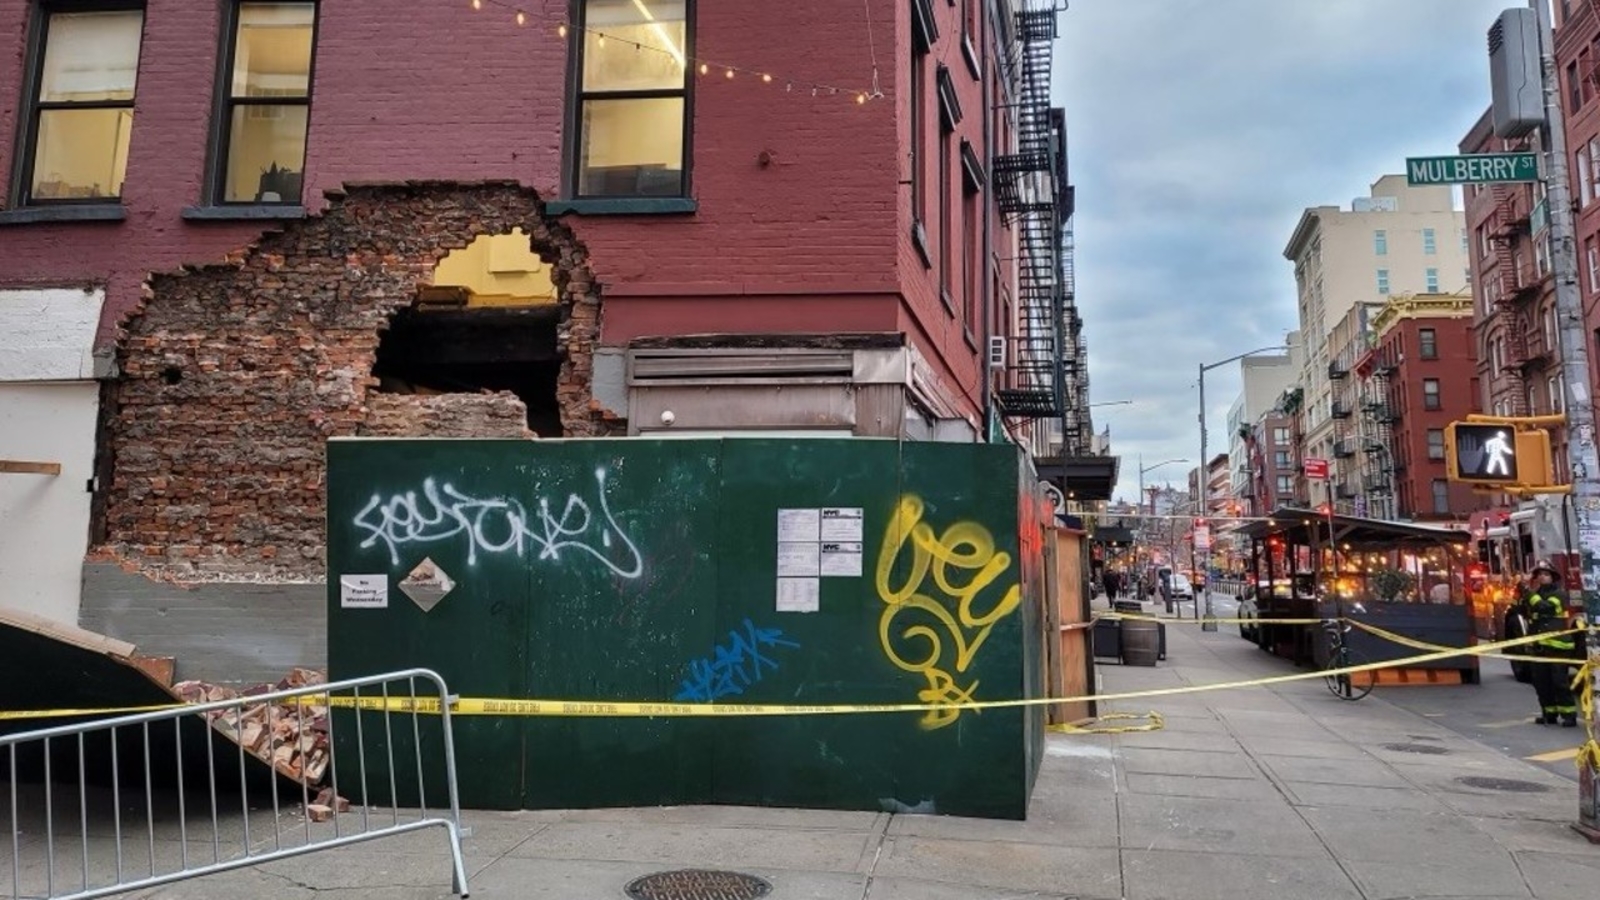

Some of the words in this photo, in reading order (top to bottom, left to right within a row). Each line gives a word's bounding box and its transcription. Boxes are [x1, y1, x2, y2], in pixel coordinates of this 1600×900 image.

[1412, 157, 1518, 182] MULBERRY
[1522, 156, 1534, 168] ST
[823, 509, 840, 517] NYC
